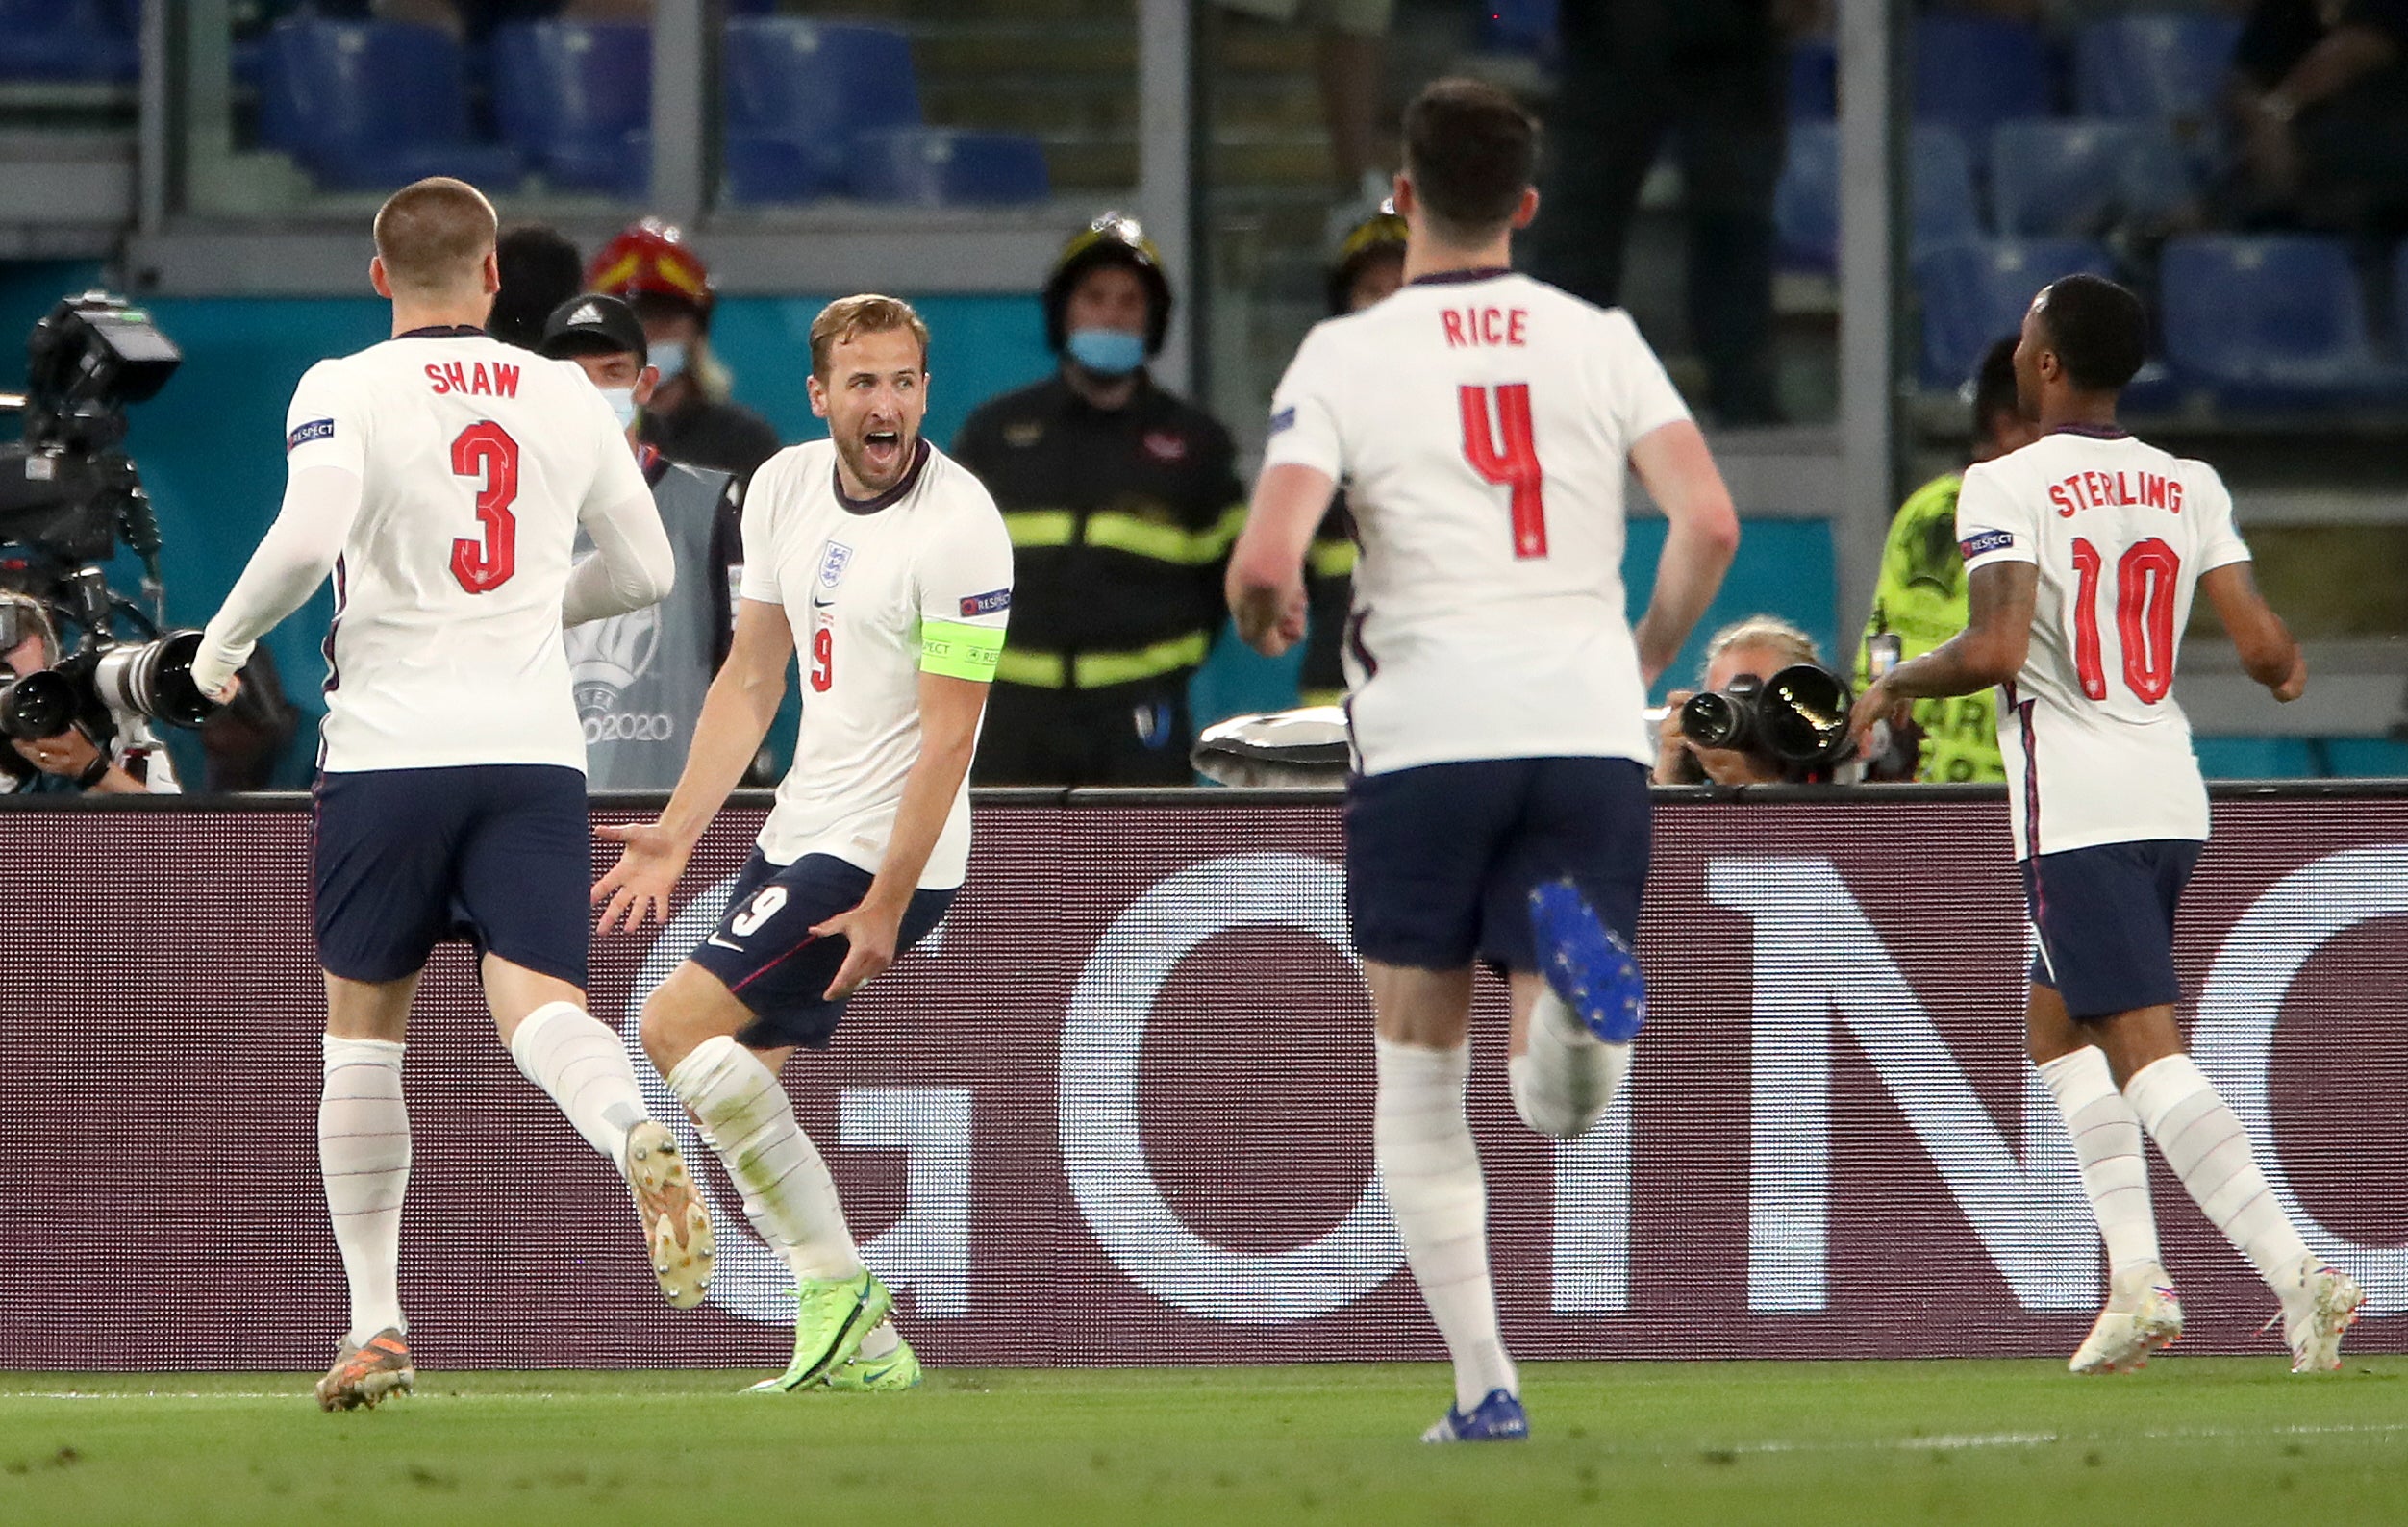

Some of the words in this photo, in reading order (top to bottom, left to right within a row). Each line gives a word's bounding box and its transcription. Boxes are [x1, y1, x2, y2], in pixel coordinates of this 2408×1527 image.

[1440, 307, 1528, 347] RICE
[425, 361, 520, 399] SHAW
[292, 423, 334, 444] RESPECT
[1457, 383, 1547, 560] 4
[449, 419, 519, 594] 3
[2049, 471, 2183, 519] STERLING
[1971, 533, 2013, 551] RESPECT
[977, 593, 1011, 610] RESPEC
[2072, 537, 2180, 705] 10
[810, 628, 833, 693] 9
[923, 639, 951, 655] PECT
[731, 885, 788, 937] 9
